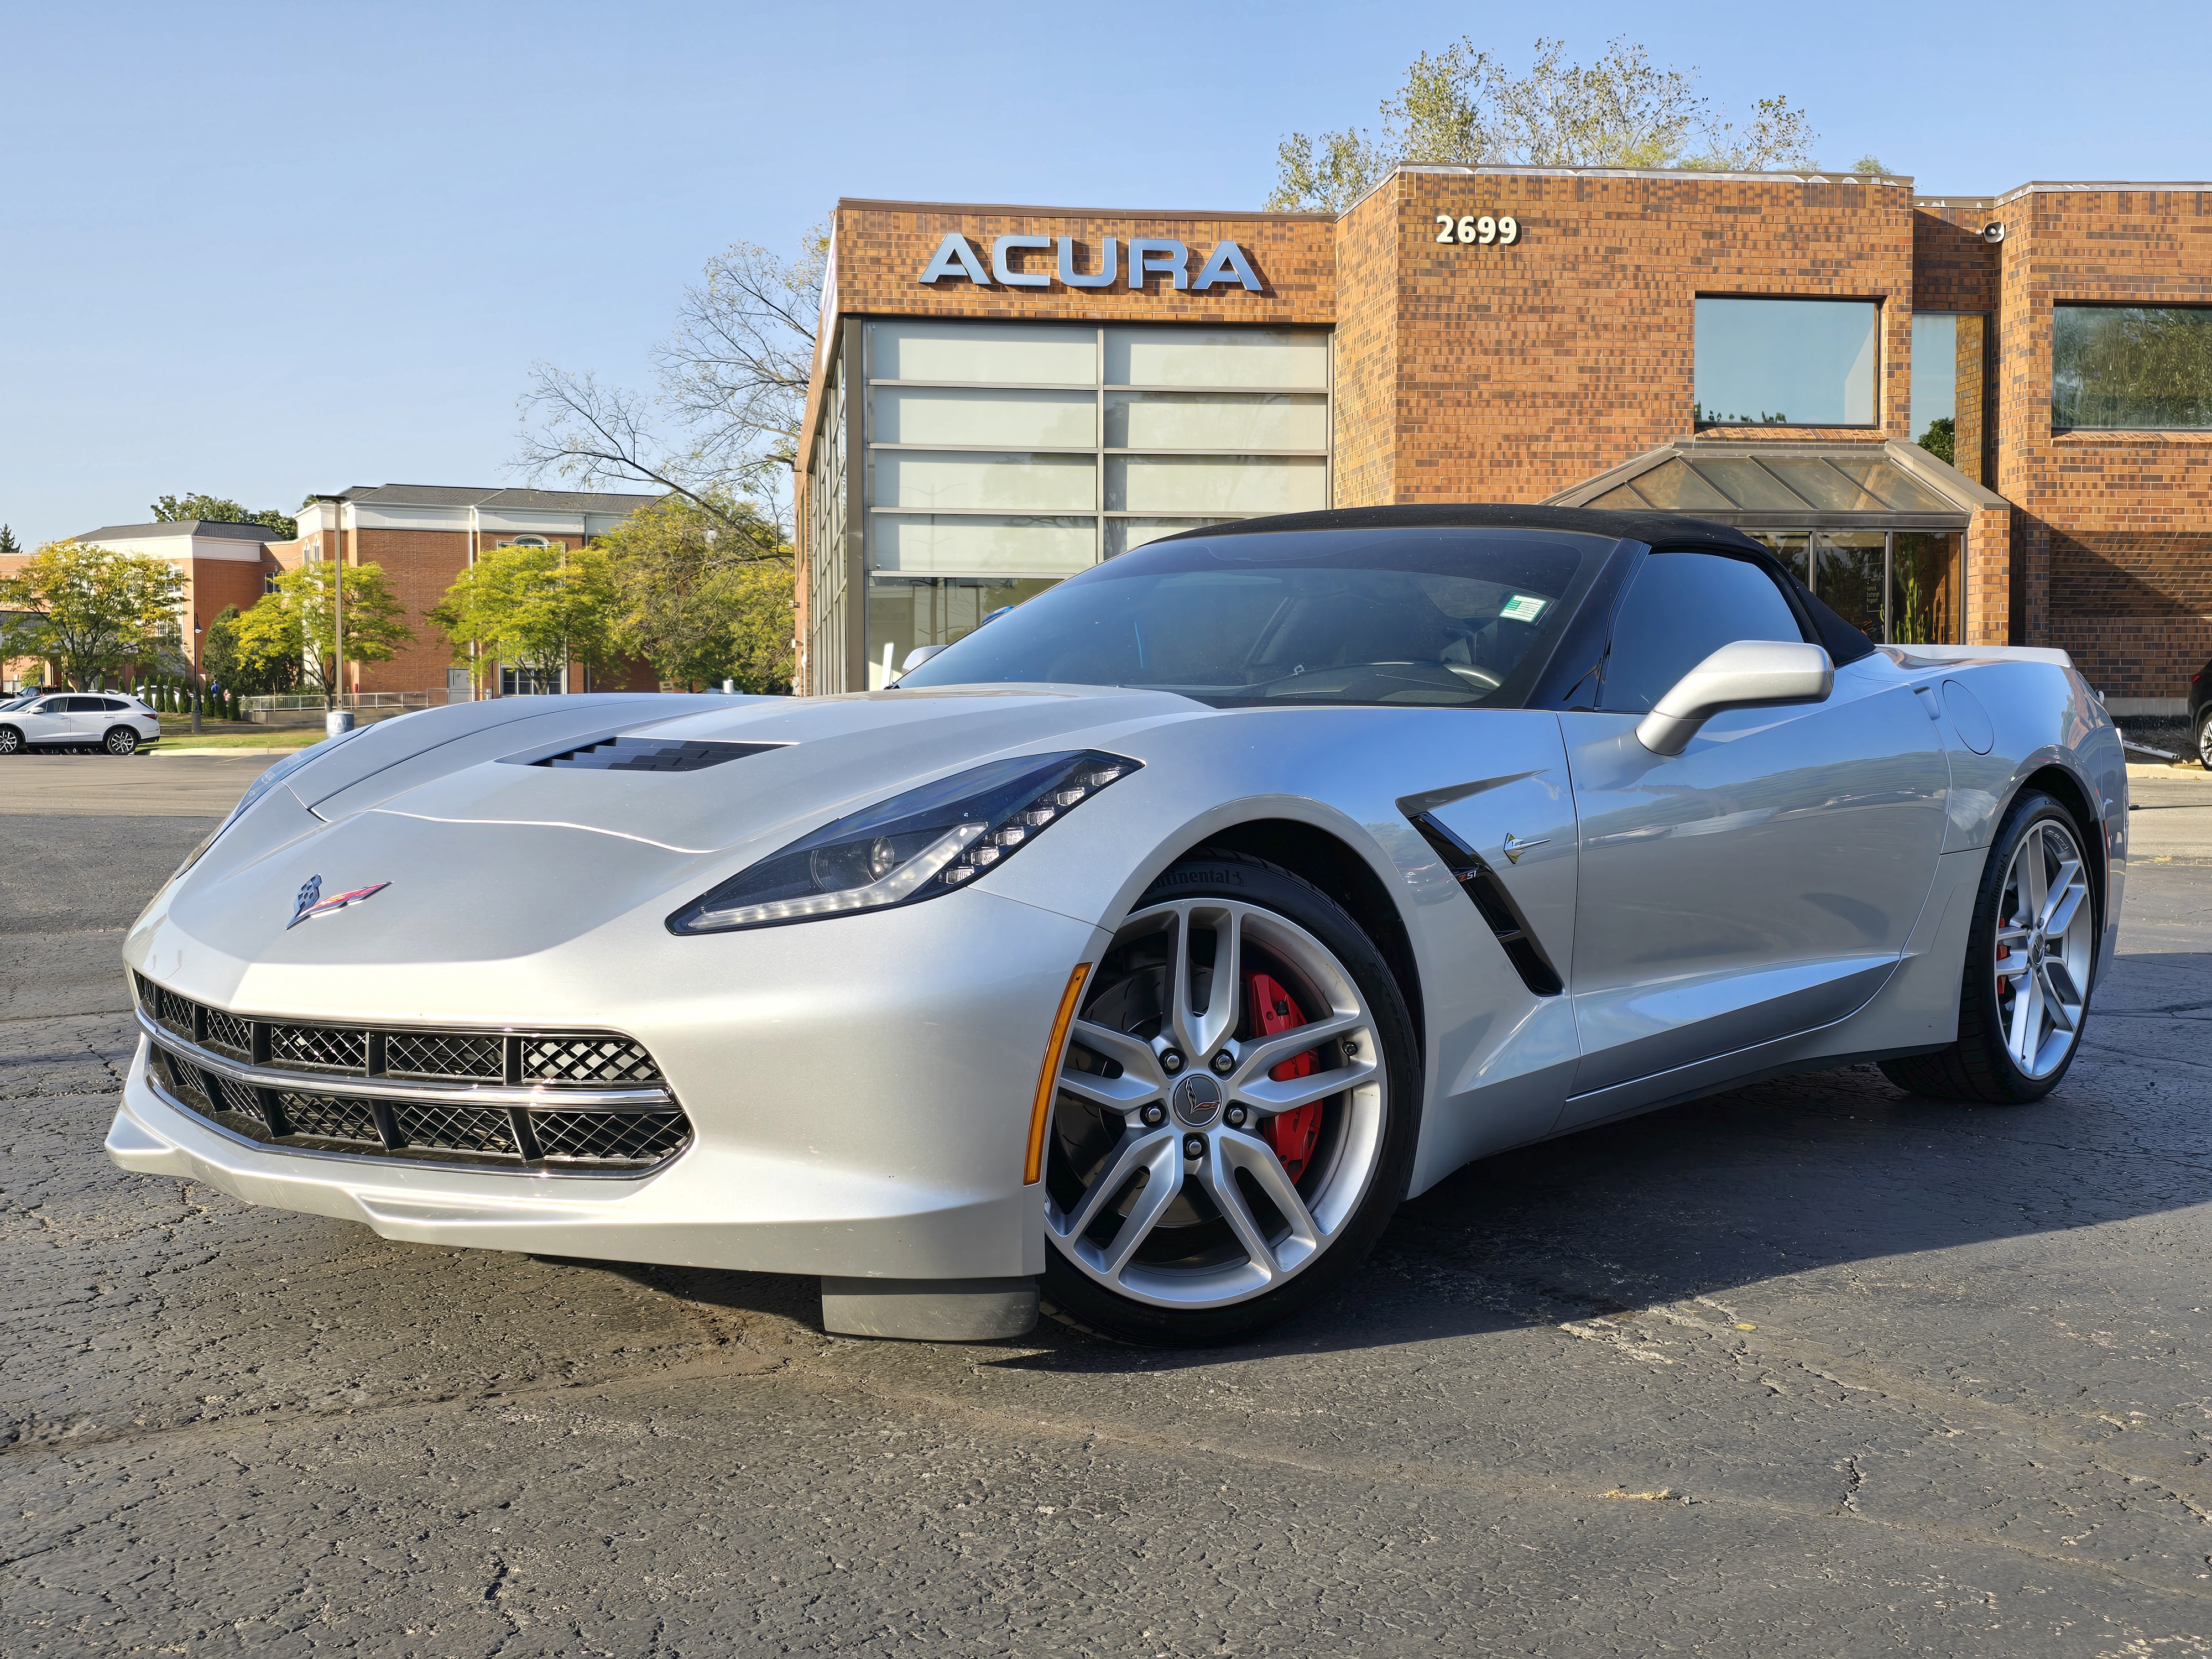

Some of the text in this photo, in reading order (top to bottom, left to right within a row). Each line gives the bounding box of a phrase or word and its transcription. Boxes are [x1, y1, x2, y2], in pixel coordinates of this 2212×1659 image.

[1436, 215, 1517, 244] 2699
[918, 232, 1264, 291] ACURA
[1458, 870, 1477, 883] Z51
